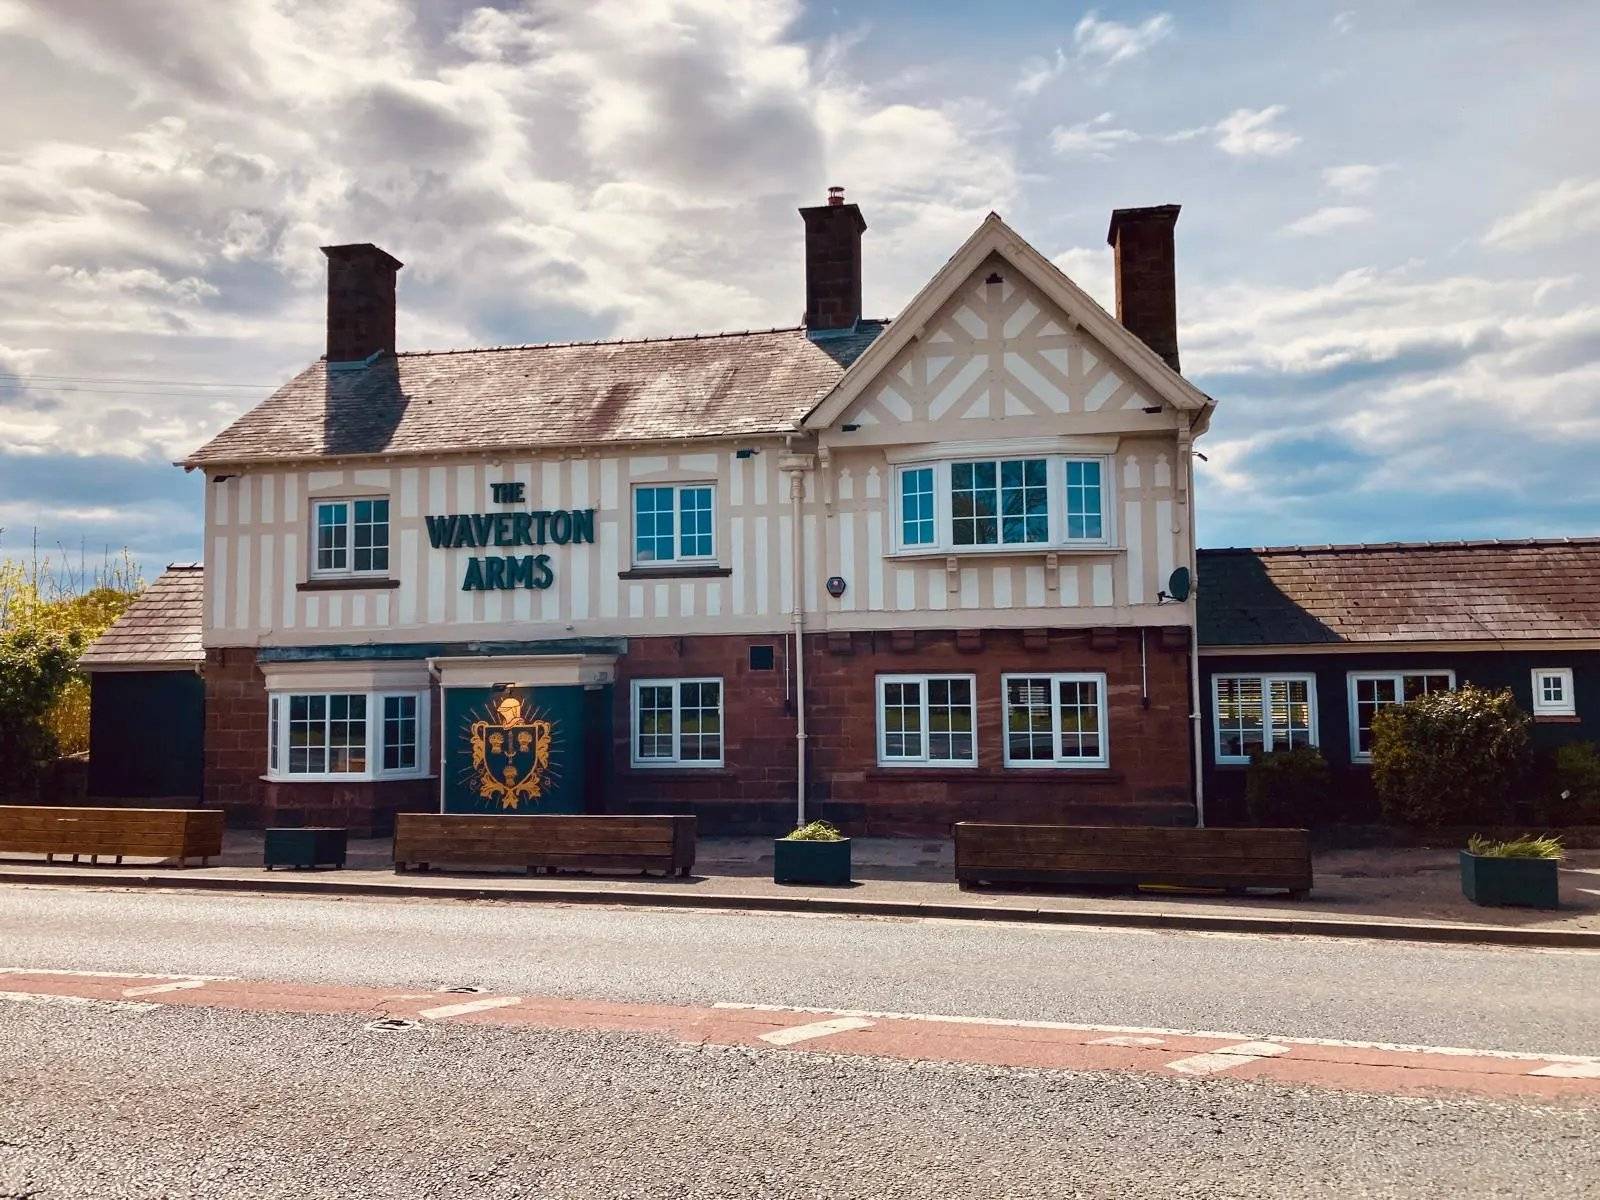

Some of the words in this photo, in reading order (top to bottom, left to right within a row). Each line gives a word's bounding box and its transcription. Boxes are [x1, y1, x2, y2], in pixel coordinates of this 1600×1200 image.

[490, 482, 525, 503] THE
[424, 509, 594, 548] WAVERTON
[462, 554, 553, 591] ARMS
